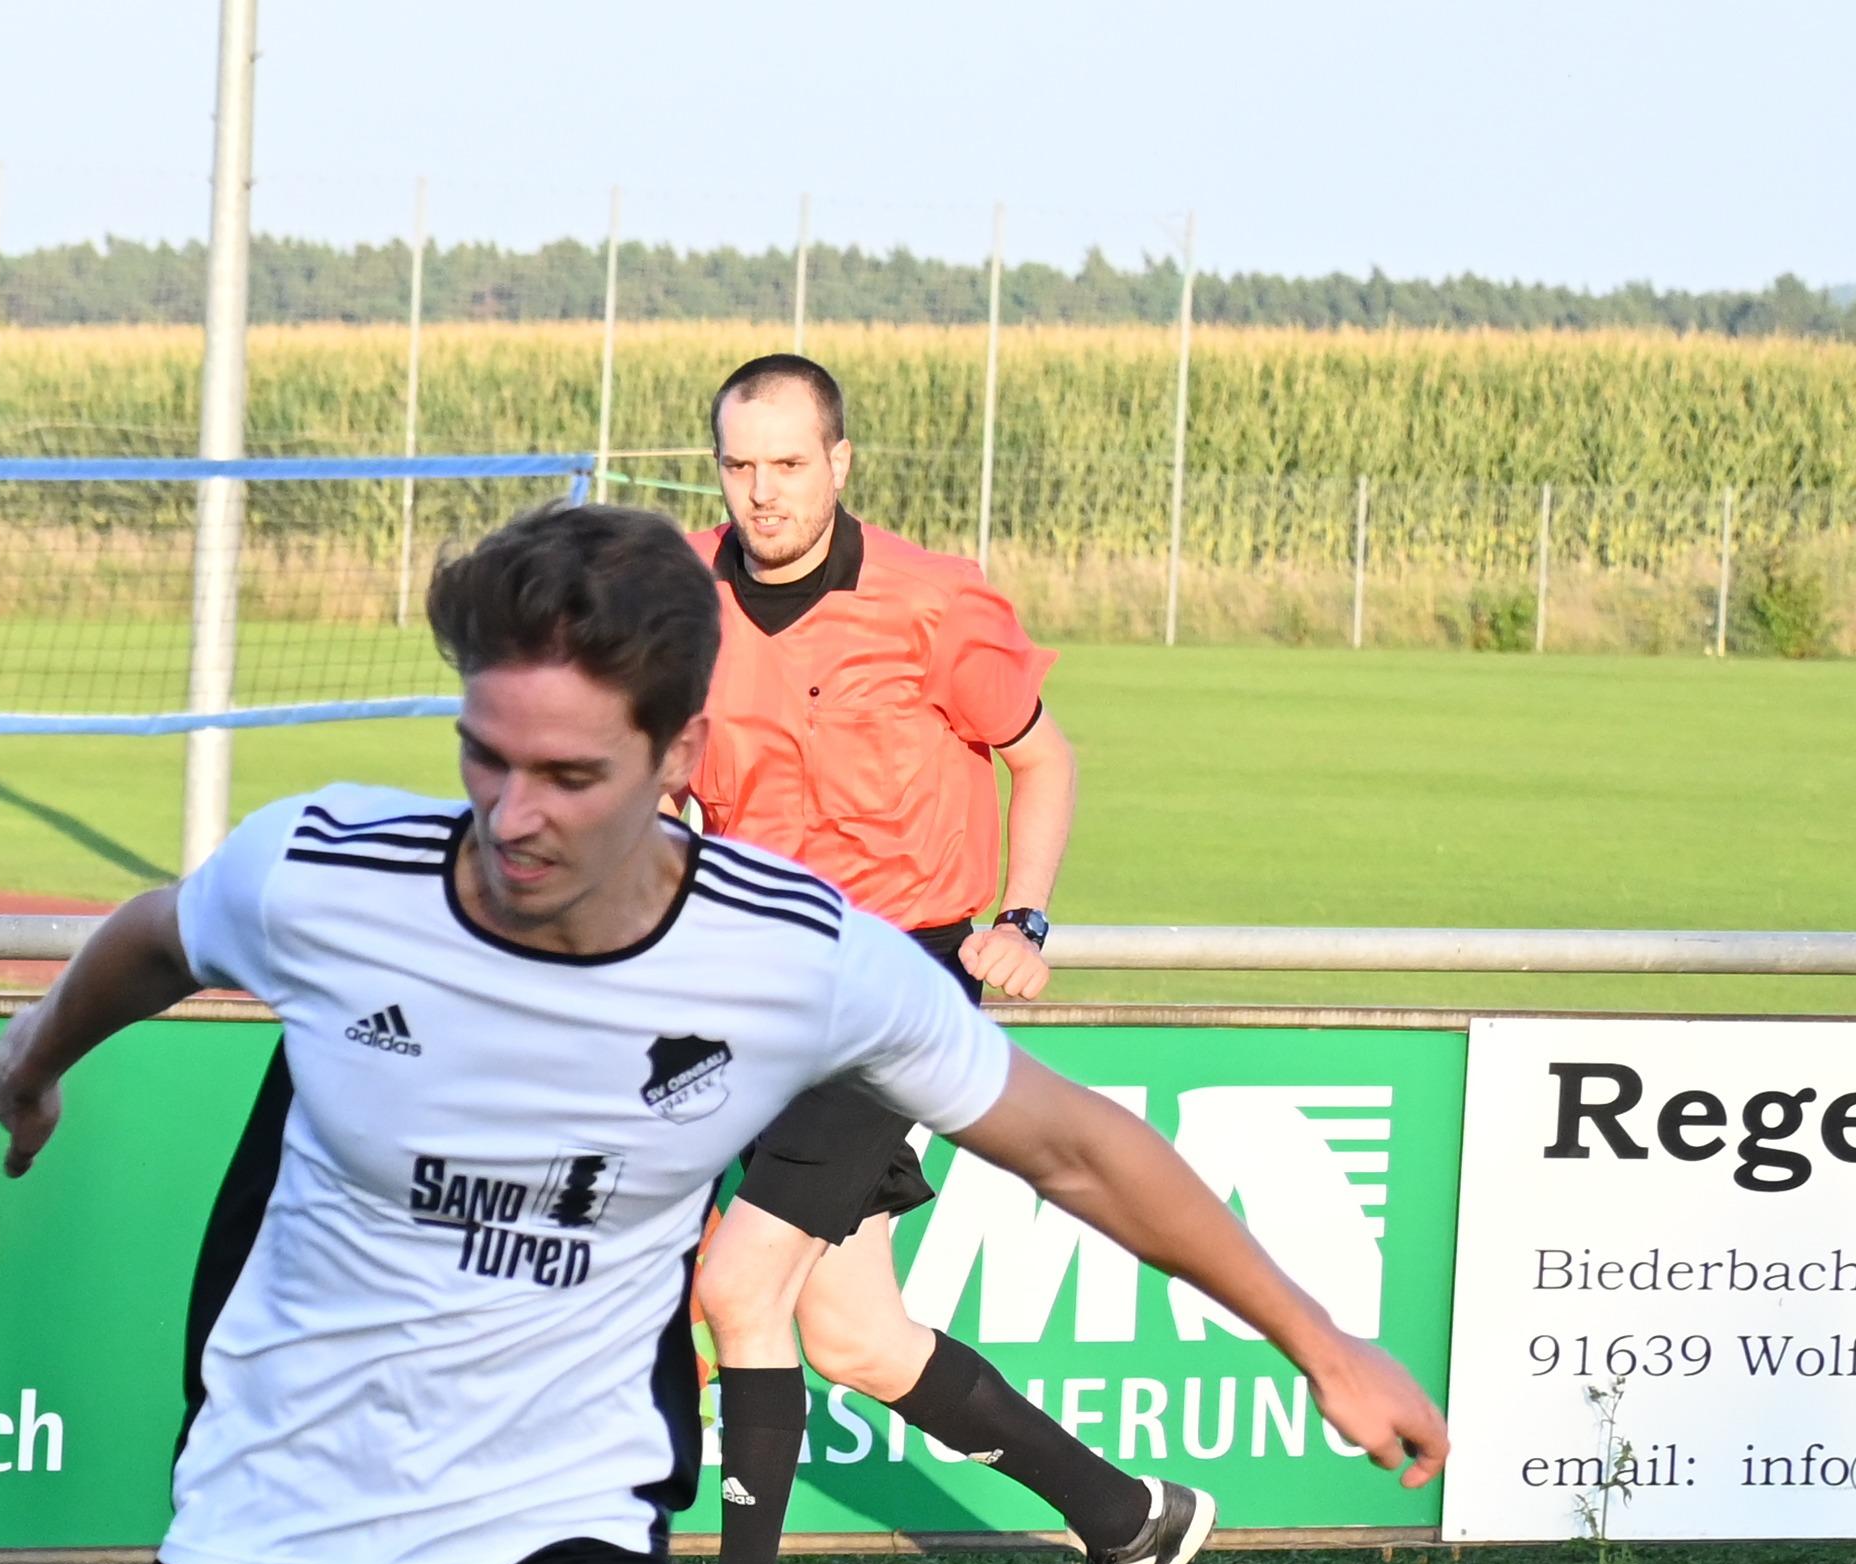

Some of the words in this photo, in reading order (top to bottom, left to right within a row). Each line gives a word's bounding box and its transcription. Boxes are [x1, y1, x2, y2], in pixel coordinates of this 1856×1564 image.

[345, 1026, 422, 1057] adidas
[1529, 1334, 1711, 1377] 91639
[1522, 1444, 1695, 1487] email:
[1741, 1443, 1856, 1490] info
